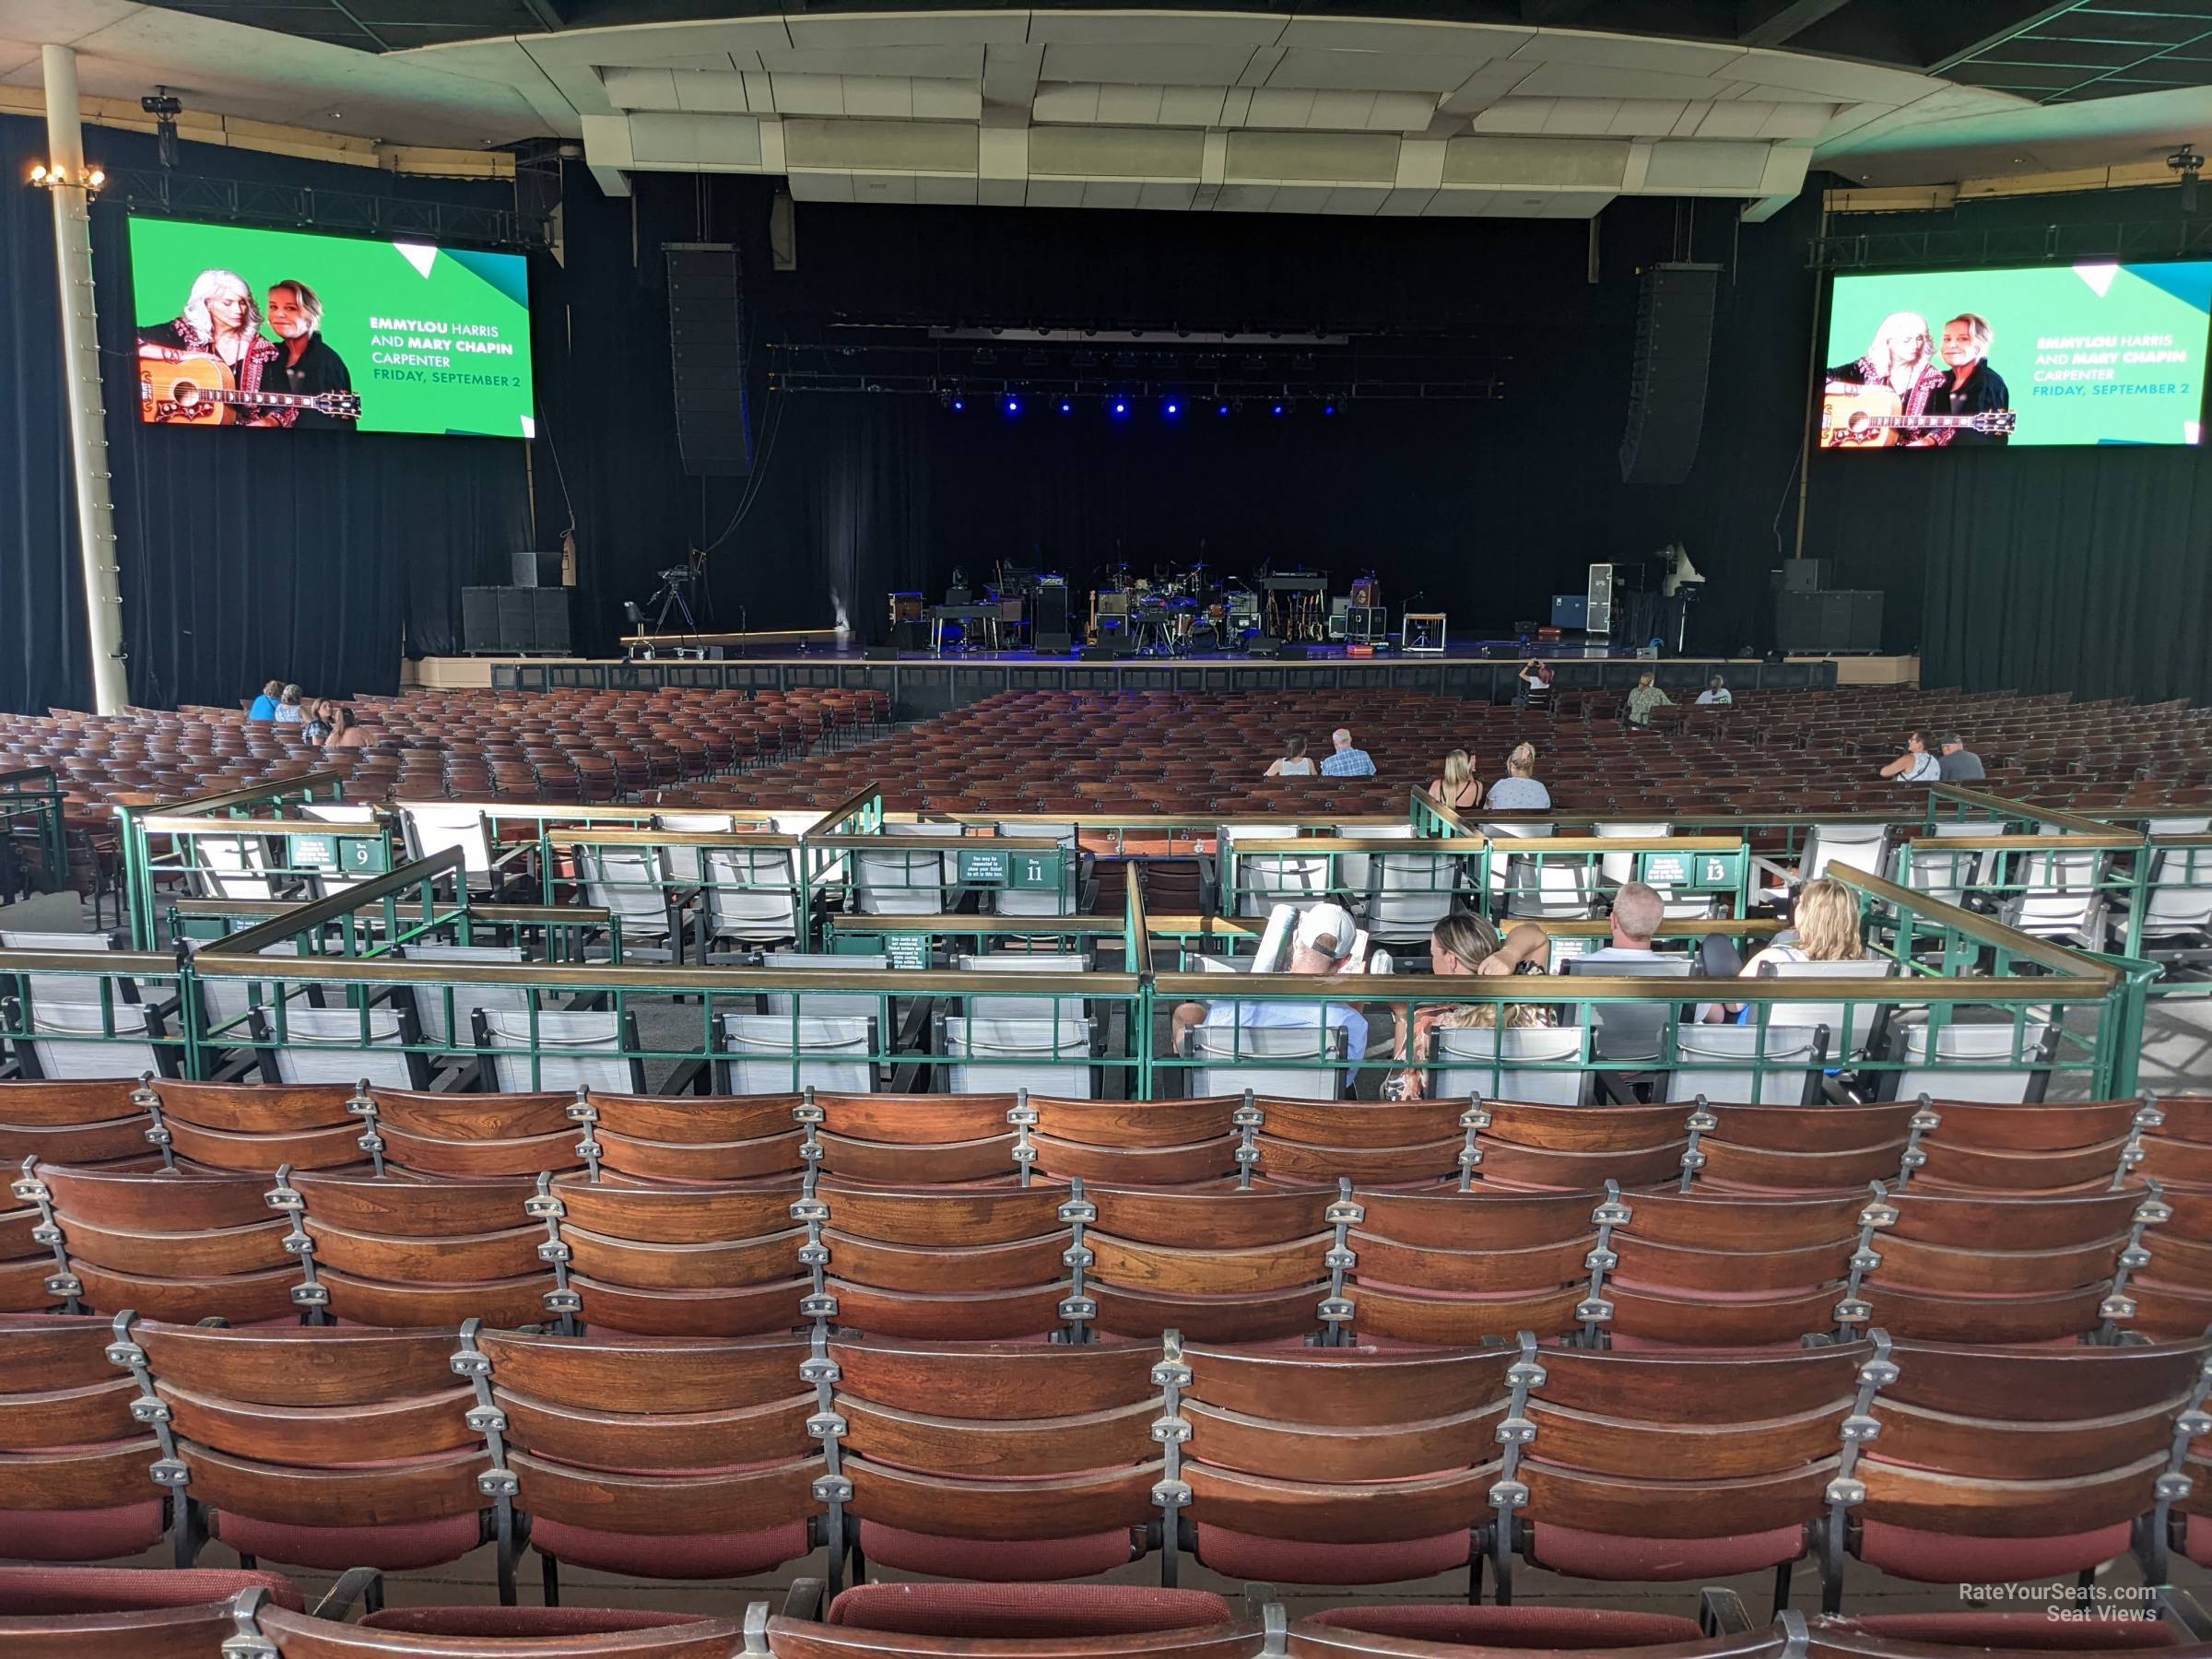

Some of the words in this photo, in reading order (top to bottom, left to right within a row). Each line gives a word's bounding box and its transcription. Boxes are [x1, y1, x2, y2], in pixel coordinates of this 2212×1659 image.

[370, 316, 448, 334] EMMYLOU
[452, 324, 499, 337] HARRIS
[371, 335, 404, 347] AND
[407, 337, 452, 351] MARY
[455, 340, 513, 355] CHAPIN
[2121, 335, 2173, 347] HARRIS
[371, 351, 451, 368] CARPENTER
[2035, 353, 2068, 366] AND
[2071, 352, 2119, 365] MARY
[2122, 350, 2187, 364] CHAPIN
[373, 369, 427, 383] FRIDAY,
[432, 371, 509, 387] SEPTEMBER
[512, 377, 521, 387] 2
[2033, 369, 2114, 382] CARPENTER
[2033, 385, 2086, 397] FRIDAY,
[2092, 383, 2176, 395] SEPTEMBER
[2181, 383, 2190, 394] 2
[357, 850, 368, 865] 9
[1027, 865, 1043, 881] 11
[1706, 865, 1724, 881] 13
